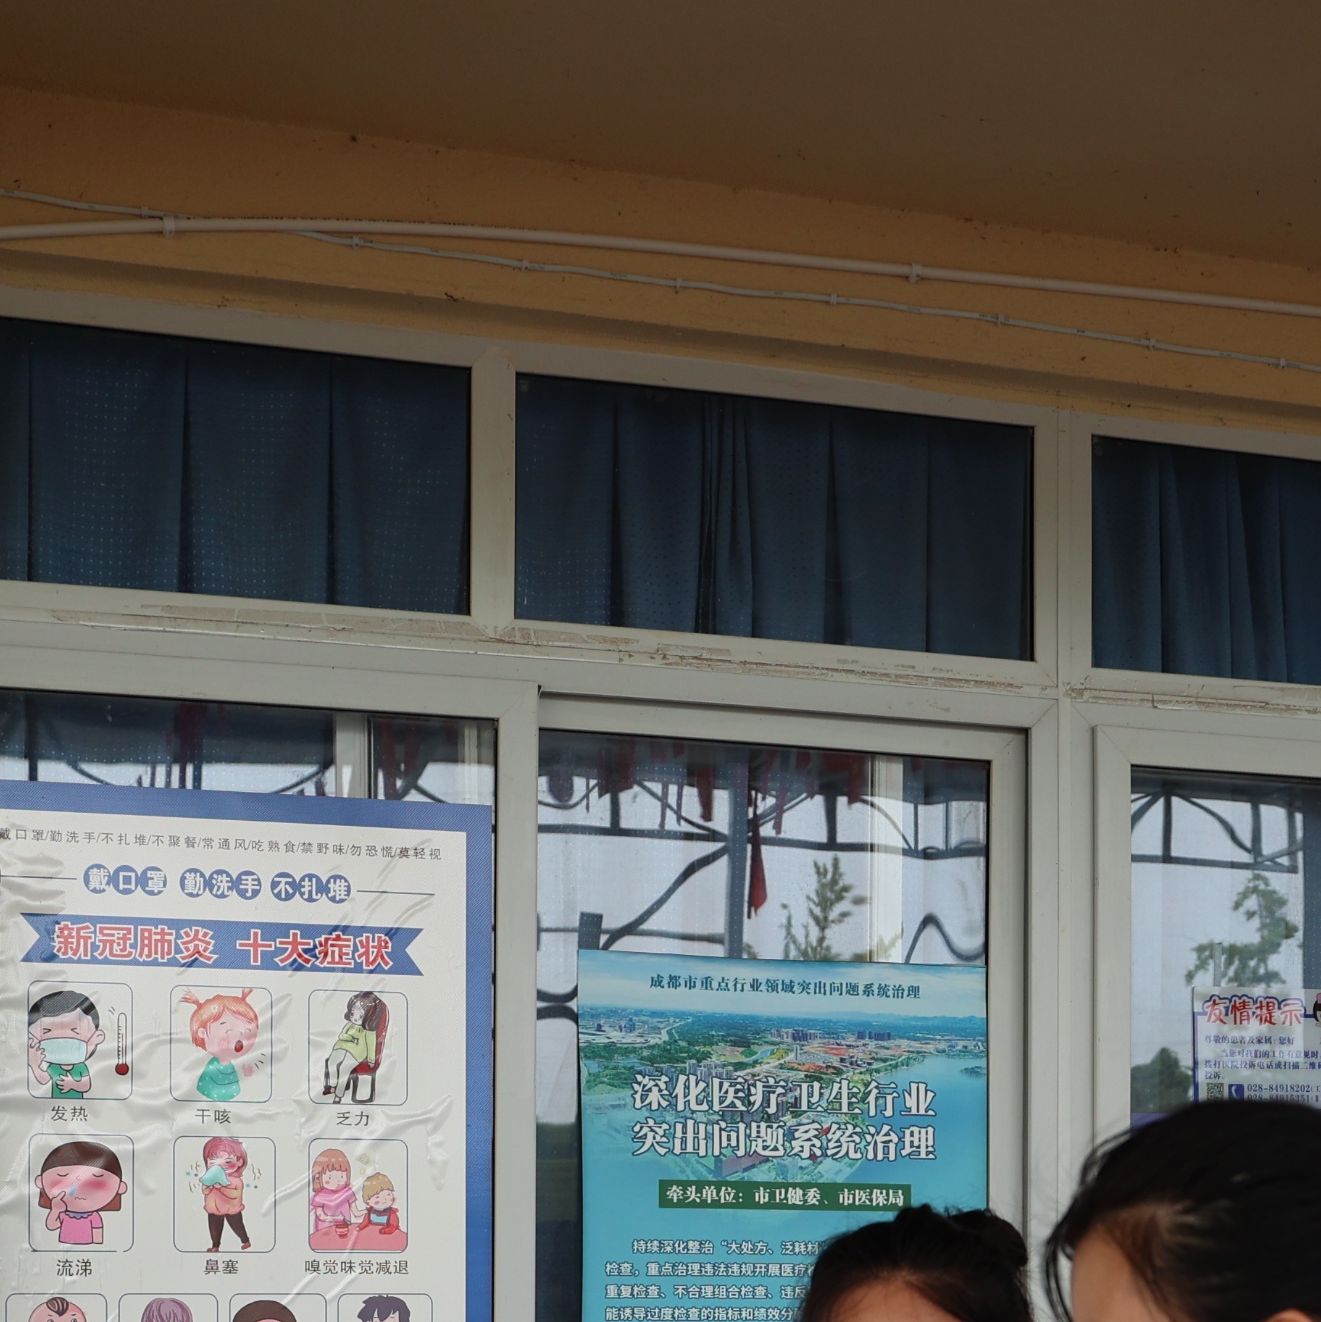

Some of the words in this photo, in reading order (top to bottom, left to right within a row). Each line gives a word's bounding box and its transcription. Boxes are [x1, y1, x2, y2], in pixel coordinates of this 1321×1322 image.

[84, 865, 168, 895] 戴口罩
[180, 868, 262, 899] 勤洗手
[270, 872, 352, 903] 不扎堆
[54, 922, 217, 964] 新冠肺炎
[236, 929, 393, 969] 十大症状
[649, 974, 921, 1000] 成都市重点行业领域突出问题系统治理
[1205, 998, 1304, 1027] 友情提示
[631, 1073, 937, 1118] 深化医疗卫生行业
[50, 1105, 89, 1123] 发热
[195, 1107, 232, 1126] 干咳
[336, 1111, 371, 1127] 乏力
[631, 1118, 937, 1161] 突出问题系统治理
[666, 1185, 904, 1207] 牵头单位：市卫健委、市医保局
[56, 1259, 93, 1277] 流涕
[203, 1259, 239, 1276] 鼻塞
[304, 1259, 410, 1276] 嗅觉味觉减退
